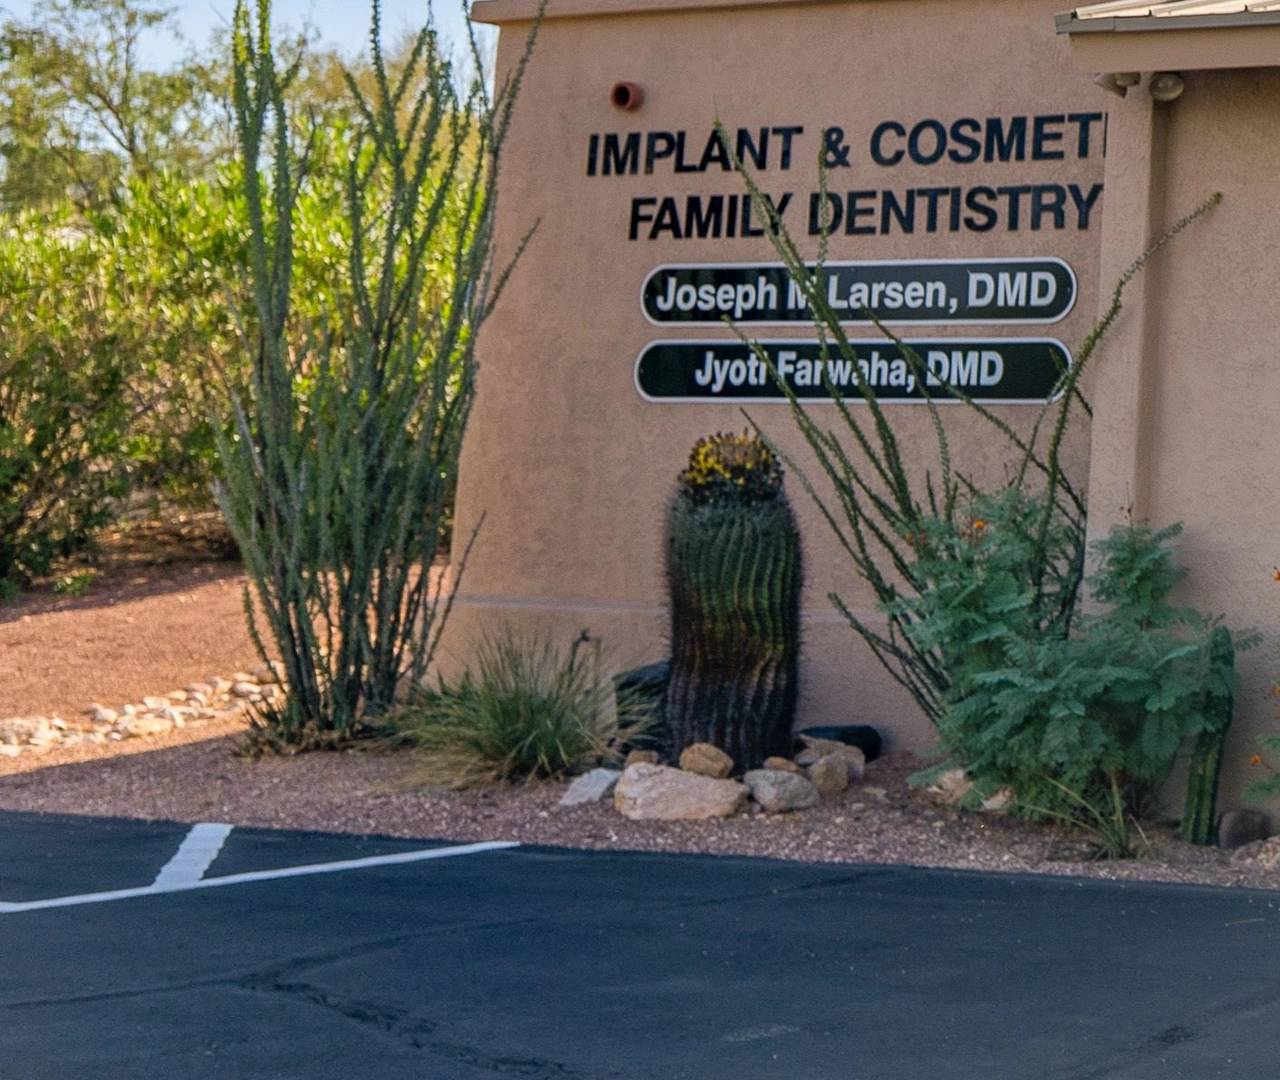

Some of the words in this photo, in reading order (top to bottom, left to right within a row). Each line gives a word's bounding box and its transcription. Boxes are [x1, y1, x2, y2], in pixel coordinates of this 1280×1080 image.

[586, 125, 804, 177] IMPLANT
[819, 126, 851, 169] &
[870, 111, 1108, 167] COSMET
[628, 191, 793, 241] FAMILY
[808, 184, 1104, 236] DENTISTRY
[656, 275, 778, 319] Joseph
[828, 274, 958, 315] Larsen,
[968, 271, 1057, 308] DMD
[695, 350, 768, 394] Jyoti
[777, 350, 915, 394] Farwaha,
[926, 350, 1004, 387] DMD
